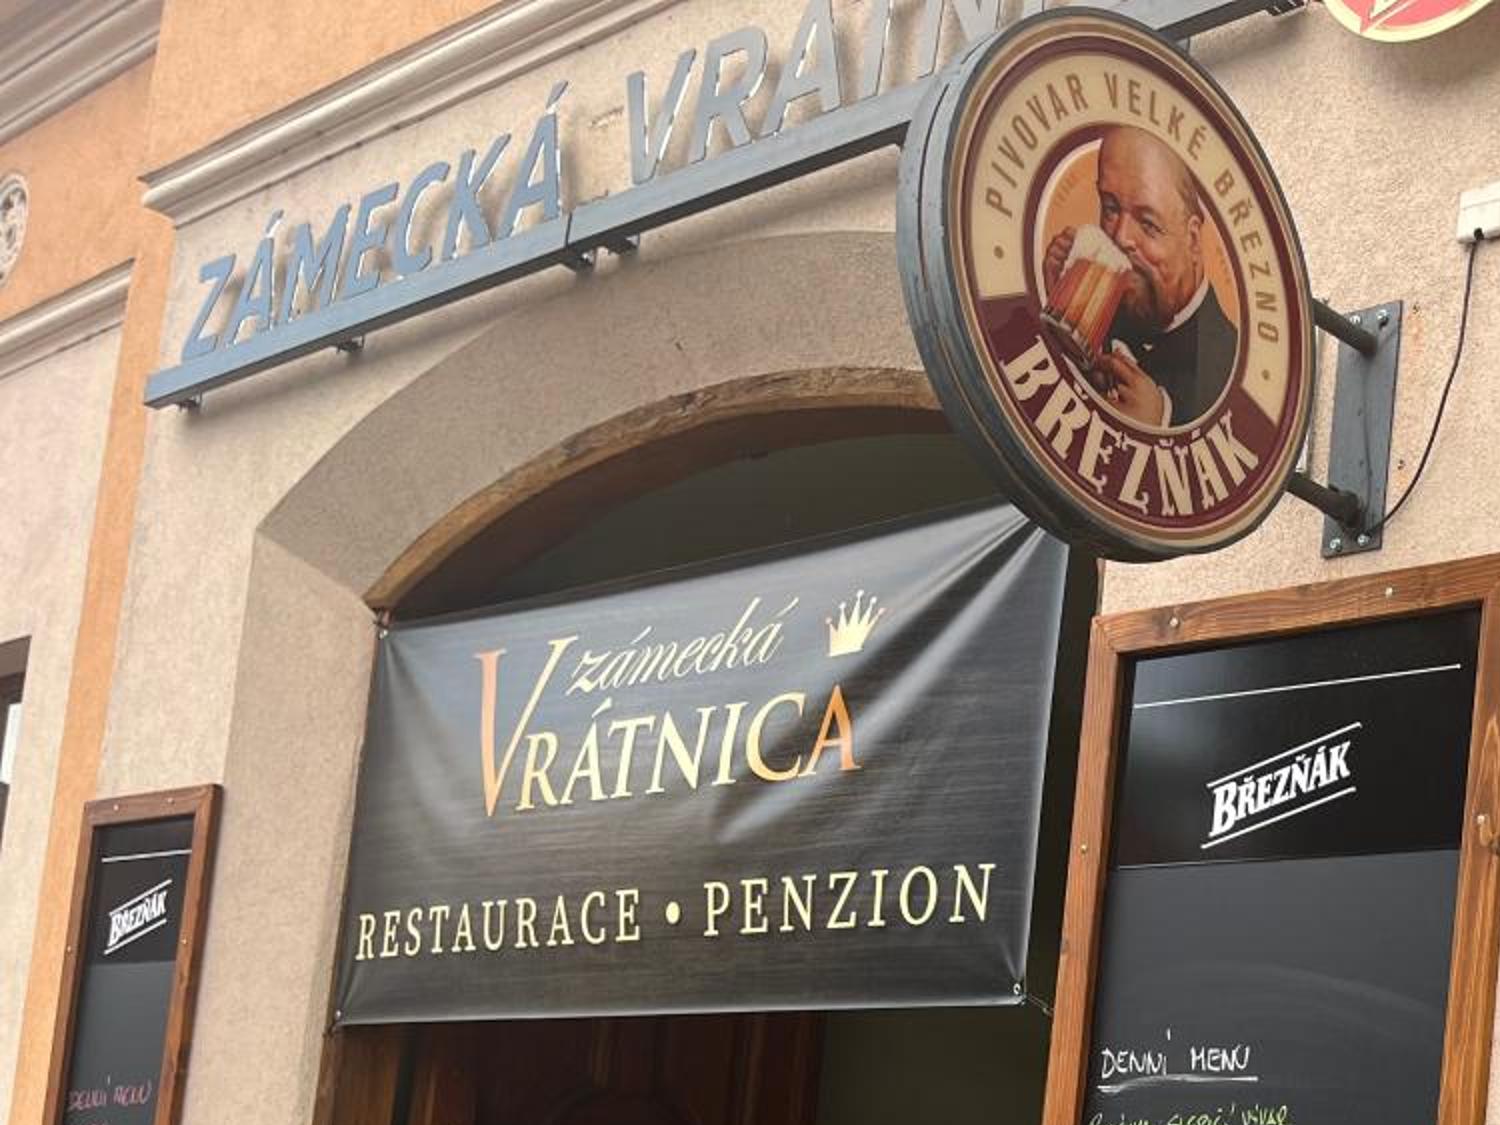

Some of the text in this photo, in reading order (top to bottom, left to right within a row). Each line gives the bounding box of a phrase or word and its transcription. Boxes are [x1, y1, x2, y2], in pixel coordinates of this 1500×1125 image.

[181, 79, 570, 359] ZÁMECKÁ
[985, 71, 1280, 346] PIVOVAR VELKÉ BŘEZNO
[565, 597, 799, 696] zámecká
[474, 635, 862, 818] VRÁTNICA
[355, 863, 997, 962] RESTAURACE PENZION
[1190, 1045, 1251, 1072] MENU
